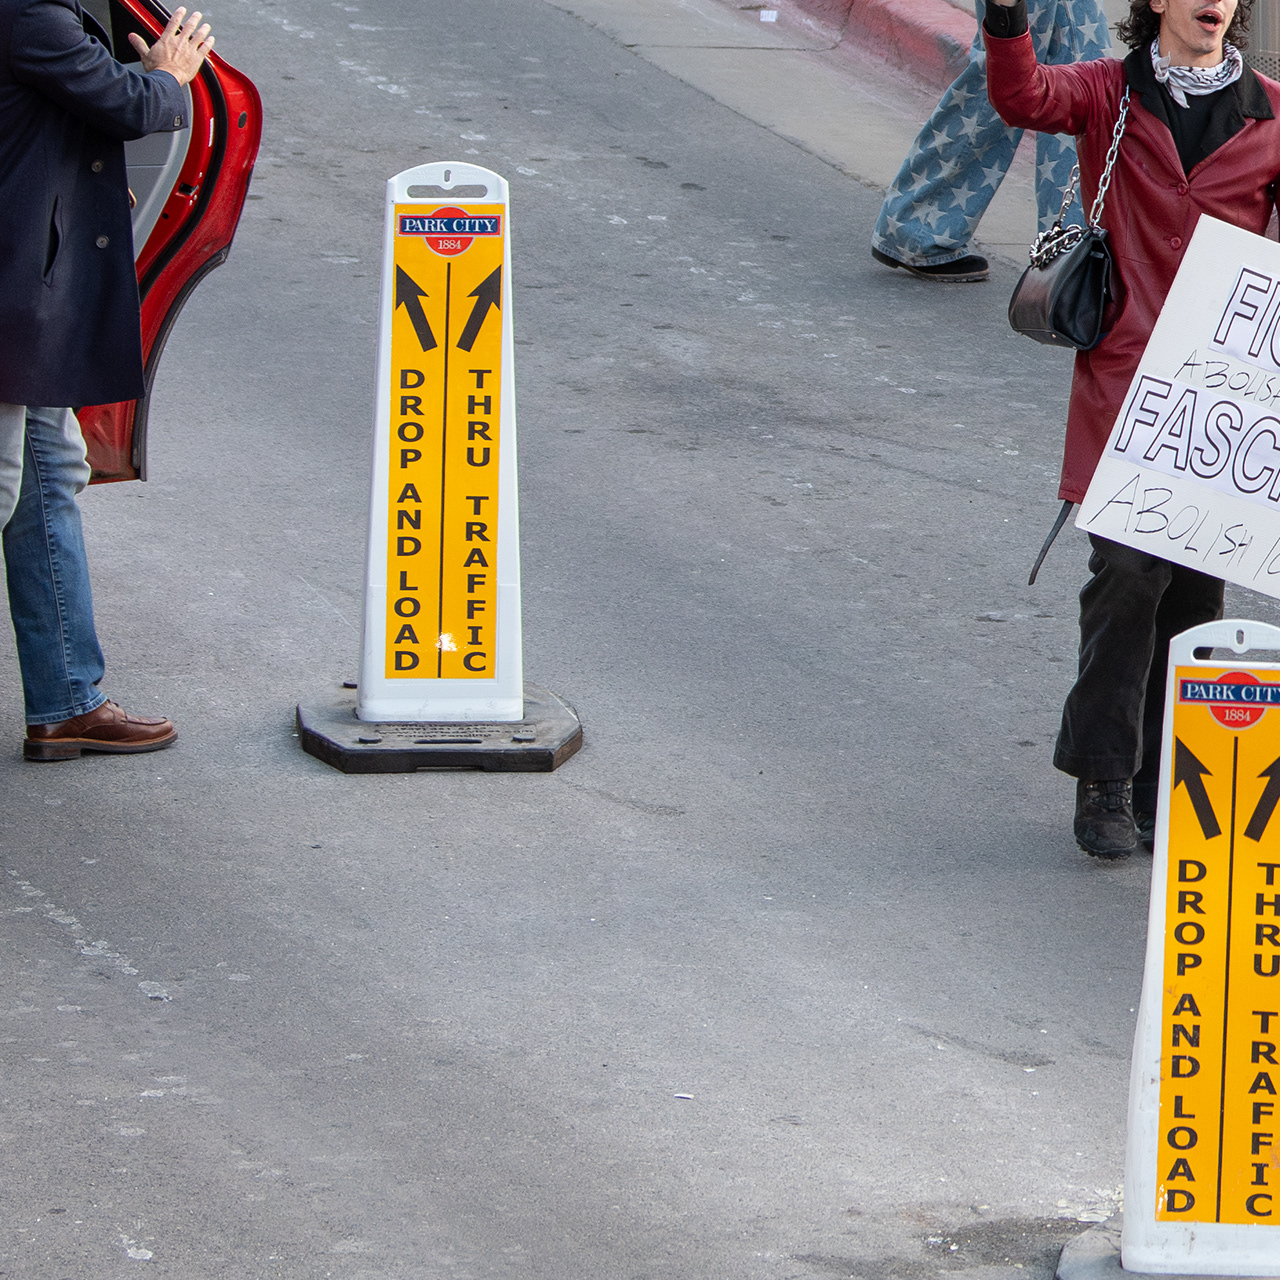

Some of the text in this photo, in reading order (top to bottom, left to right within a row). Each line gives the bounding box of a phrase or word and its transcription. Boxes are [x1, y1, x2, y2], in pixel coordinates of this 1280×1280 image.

[403, 218, 496, 232] PARK CITY
[437, 239, 461, 250] 1884
[394, 369, 425, 670] DROP AND LOAD
[463, 369, 493, 671] THRU TRAFFIC
[1087, 474, 1253, 568] ABOLISH
[1185, 683, 1236, 700] PARK
[1223, 709, 1251, 722] 1884
[1166, 859, 1208, 1213] DROP AND LOAD
[1245, 1010, 1280, 1217] TRAFFIC
